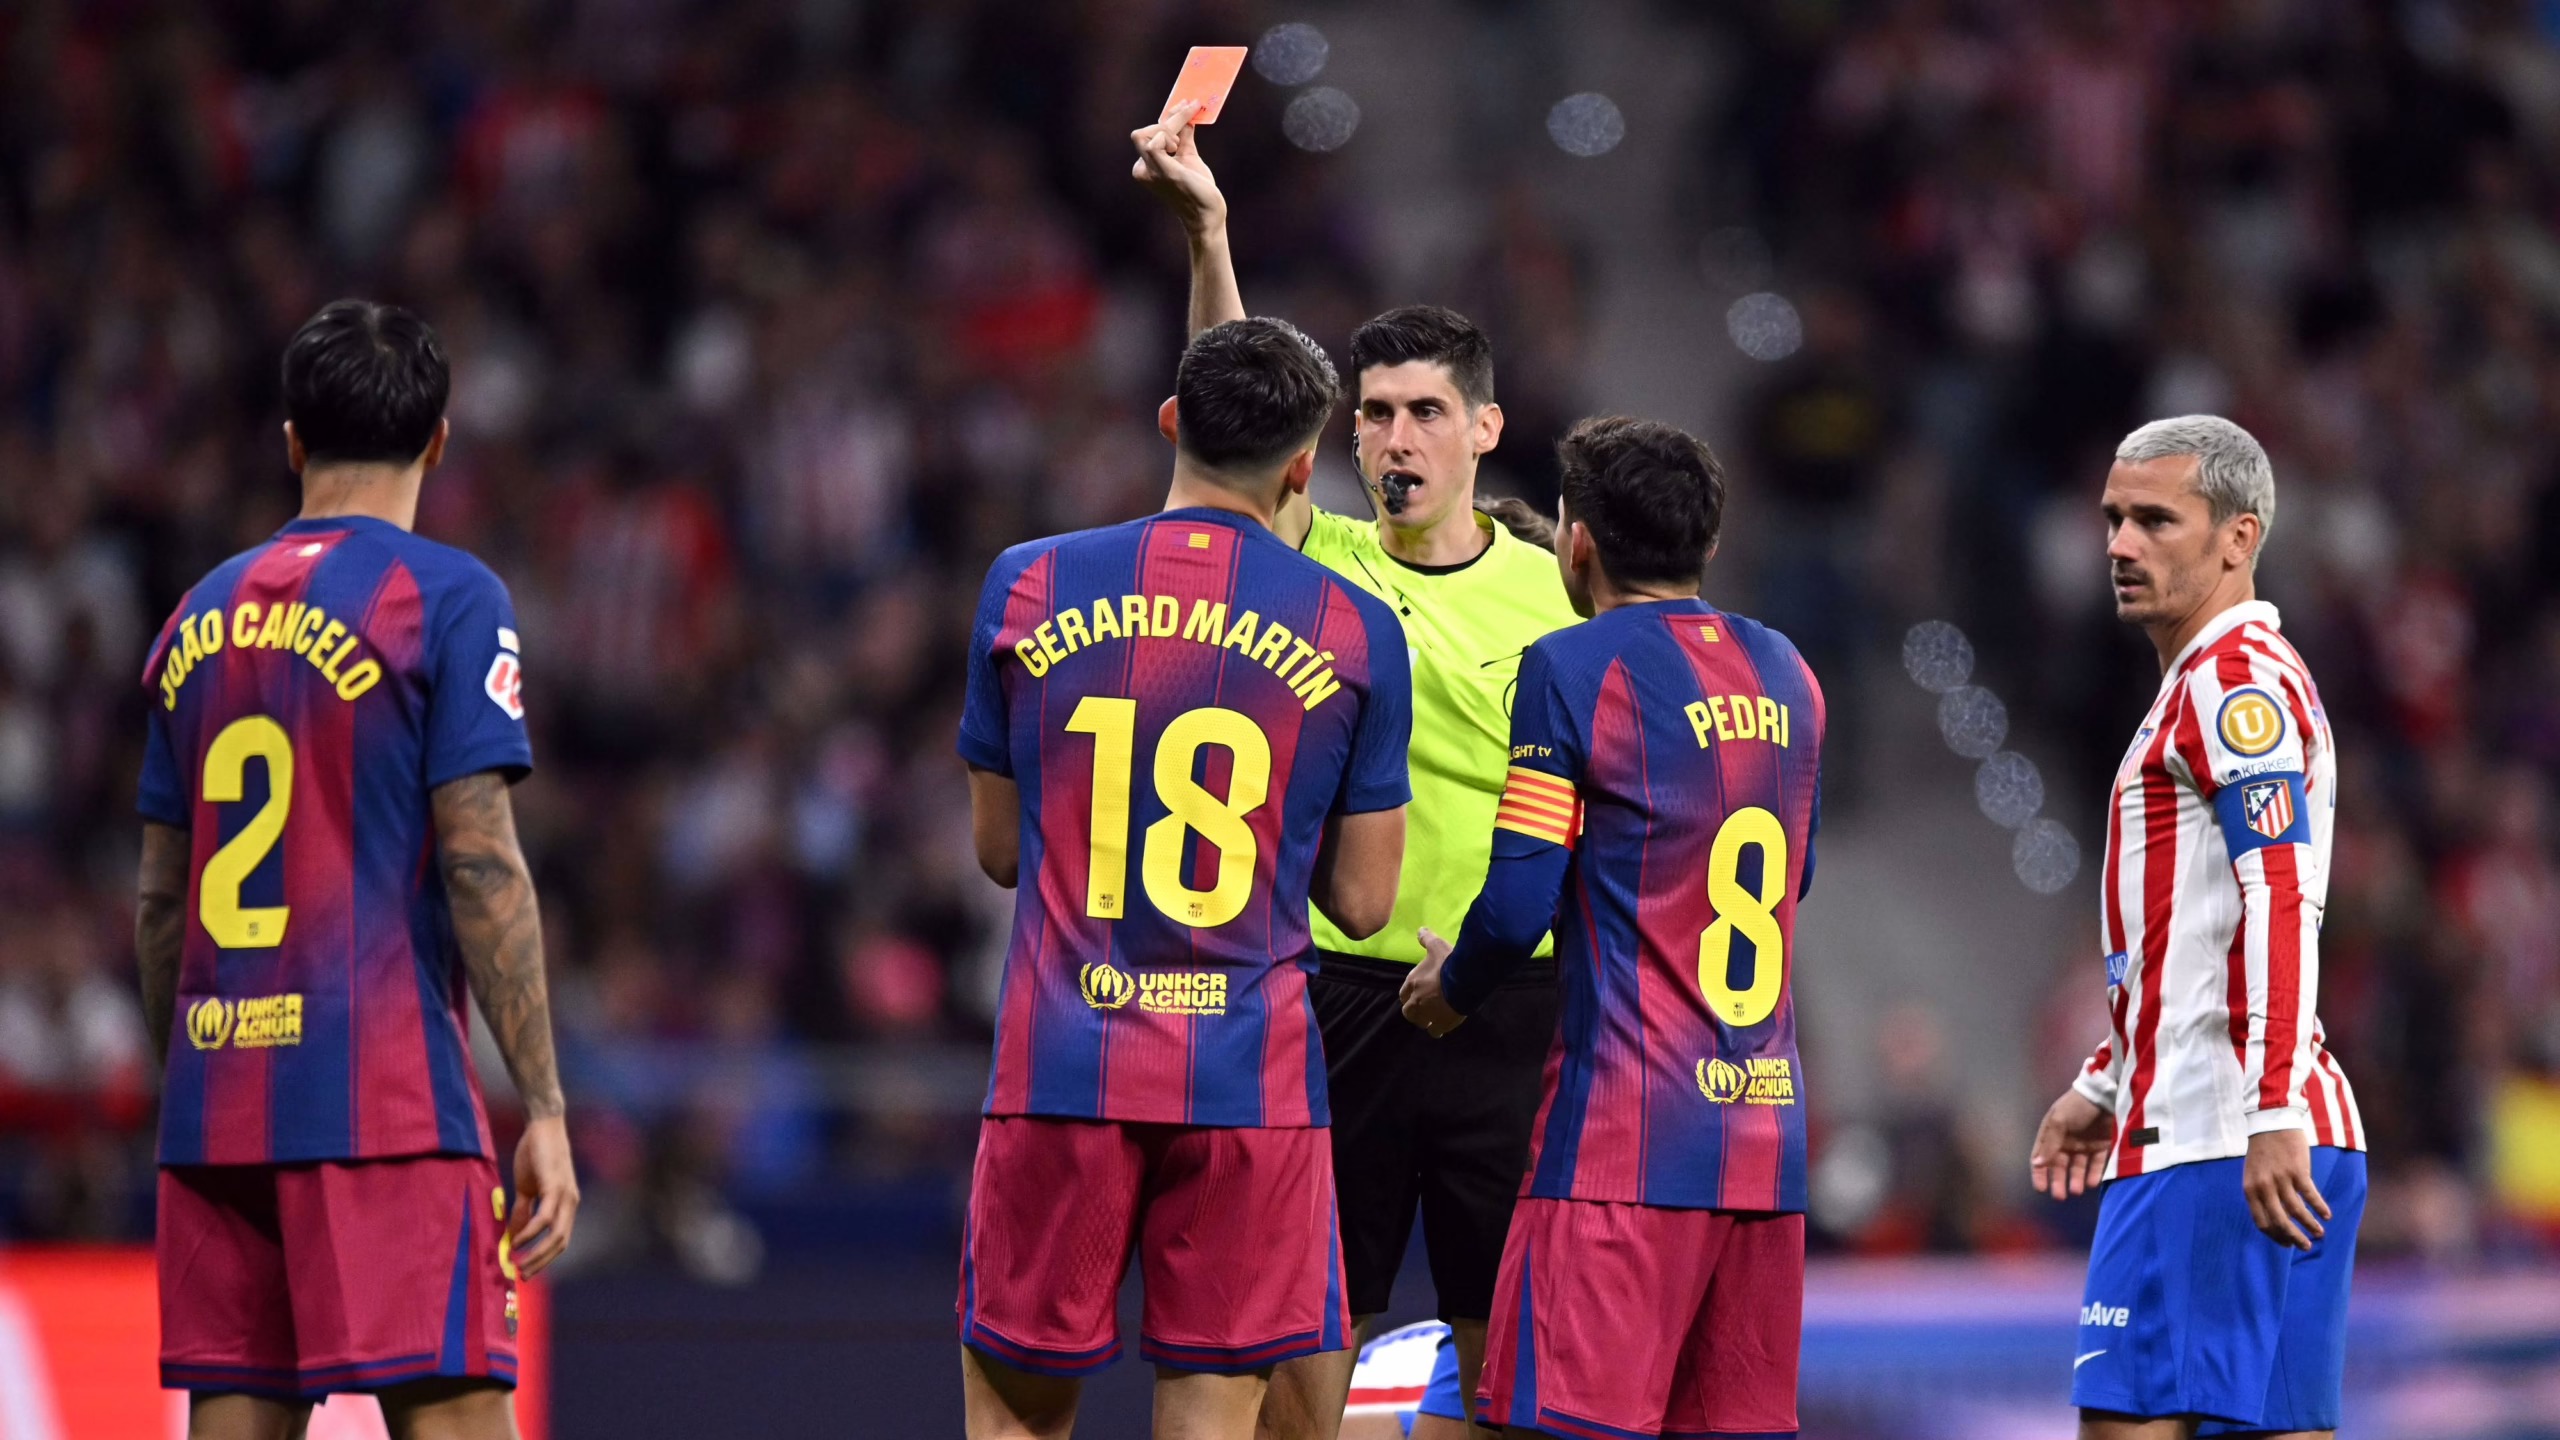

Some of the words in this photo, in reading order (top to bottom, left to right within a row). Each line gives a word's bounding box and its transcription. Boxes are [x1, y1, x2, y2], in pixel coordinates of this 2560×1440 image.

[160, 608, 225, 712] JOÃO
[232, 601, 382, 701] CANCELO
[1014, 594, 1180, 678] GERARD
[1182, 598, 1341, 712] MARTÍN
[1684, 694, 1789, 748] PEDRI
[1537, 745, 1552, 757] tv
[1064, 696, 1272, 928] 18
[199, 714, 294, 949] 2
[1697, 806, 1787, 1027] 8
[1139, 973, 1228, 991] UNHCR
[236, 993, 302, 1019] UNHCR
[1138, 990, 1227, 1007] ACNUR
[1154, 1006, 1166, 1014] UN
[1197, 1007, 1226, 1016] Agency
[233, 1016, 302, 1041] ACNUR
[1745, 1058, 1791, 1078] UNHCR
[1745, 1077, 1794, 1097] ACNUR
